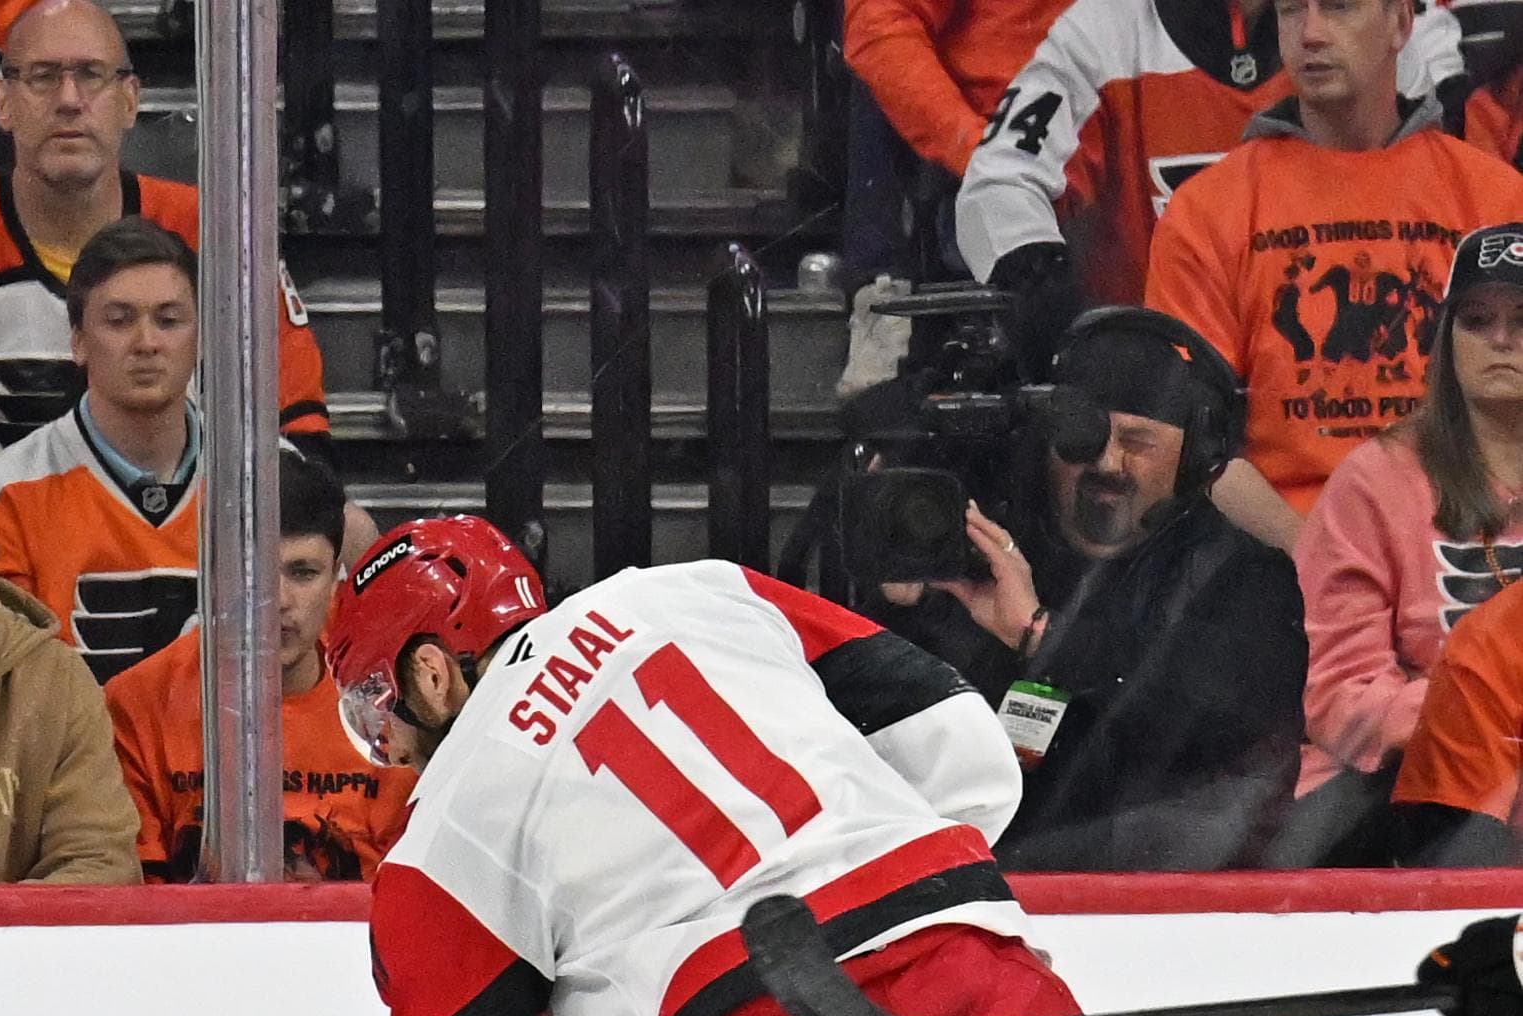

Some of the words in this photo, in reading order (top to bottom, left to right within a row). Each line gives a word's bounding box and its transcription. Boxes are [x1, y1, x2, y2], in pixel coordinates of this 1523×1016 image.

[1311, 220, 1393, 243] THINGS
[355, 541, 409, 588] Lenovo
[514, 576, 537, 608] 11
[509, 611, 635, 746] STAAL
[573, 641, 823, 889] 11
